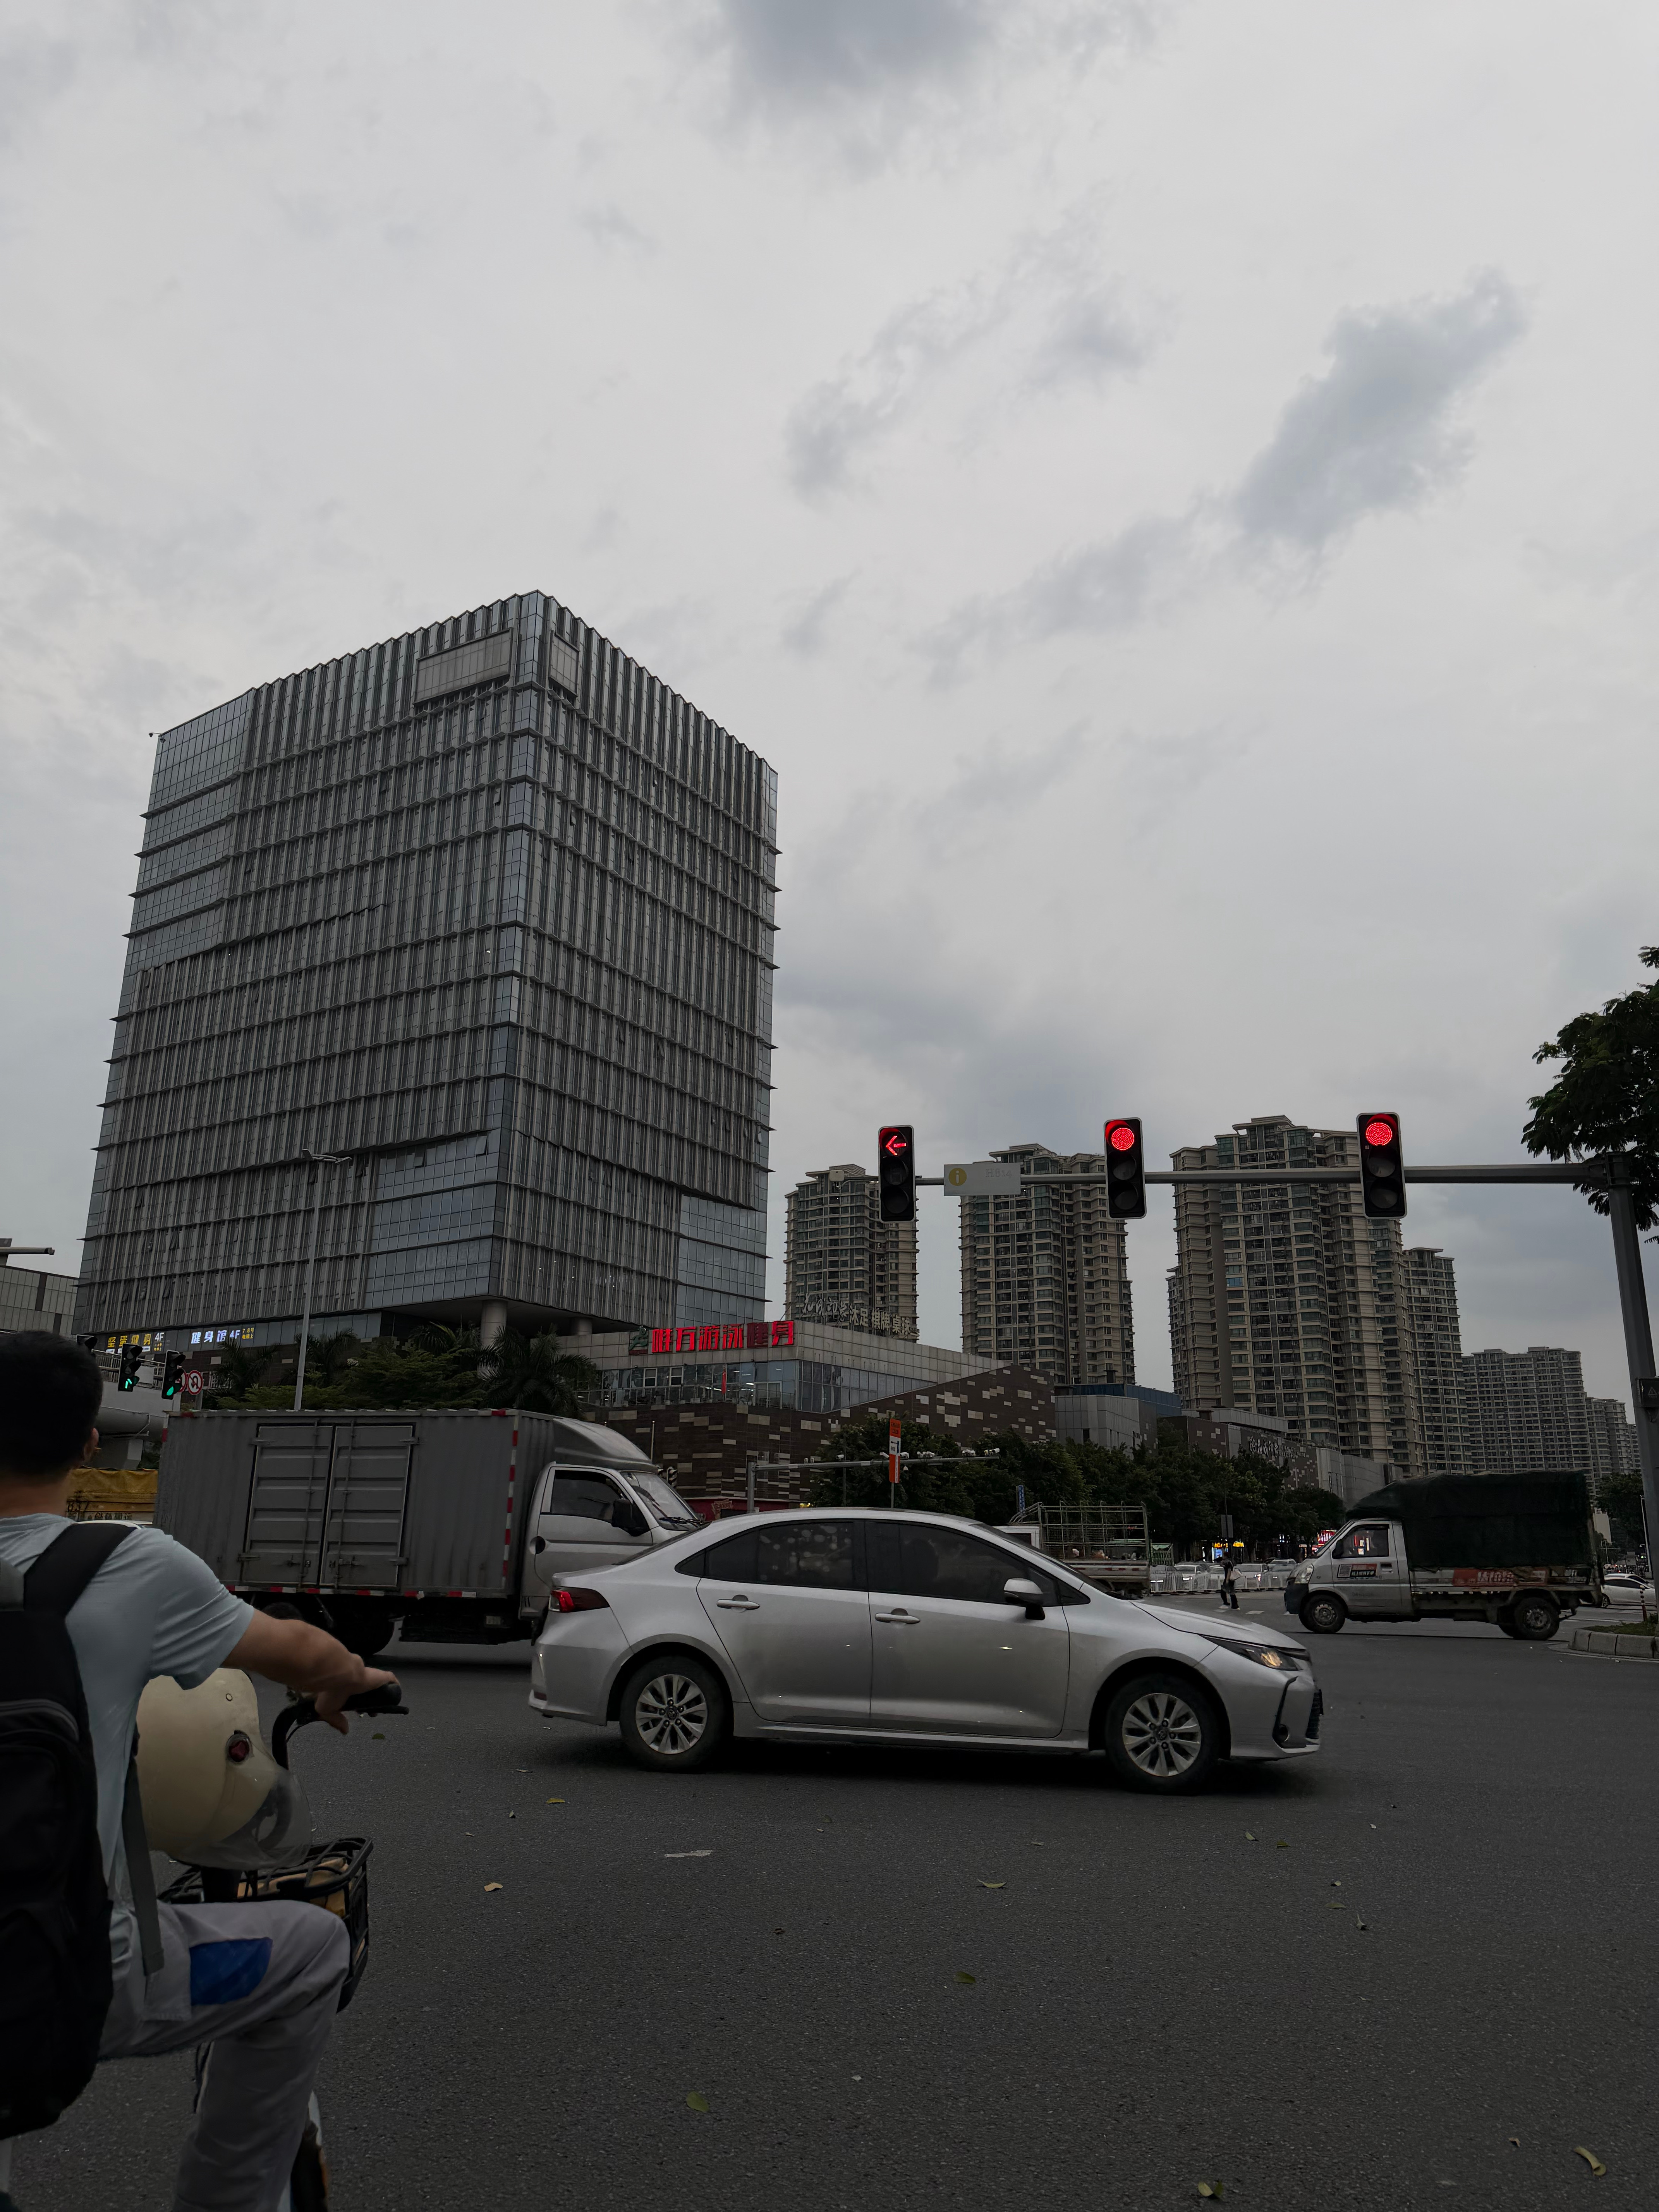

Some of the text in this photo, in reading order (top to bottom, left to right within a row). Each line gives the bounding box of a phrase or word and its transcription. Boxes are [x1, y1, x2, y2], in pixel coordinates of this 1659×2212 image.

[155, 1332, 165, 1341] 4F
[191, 1329, 240, 1344] 健身馆 4F
[652, 1320, 794, 1353] 唯万游泳健身
